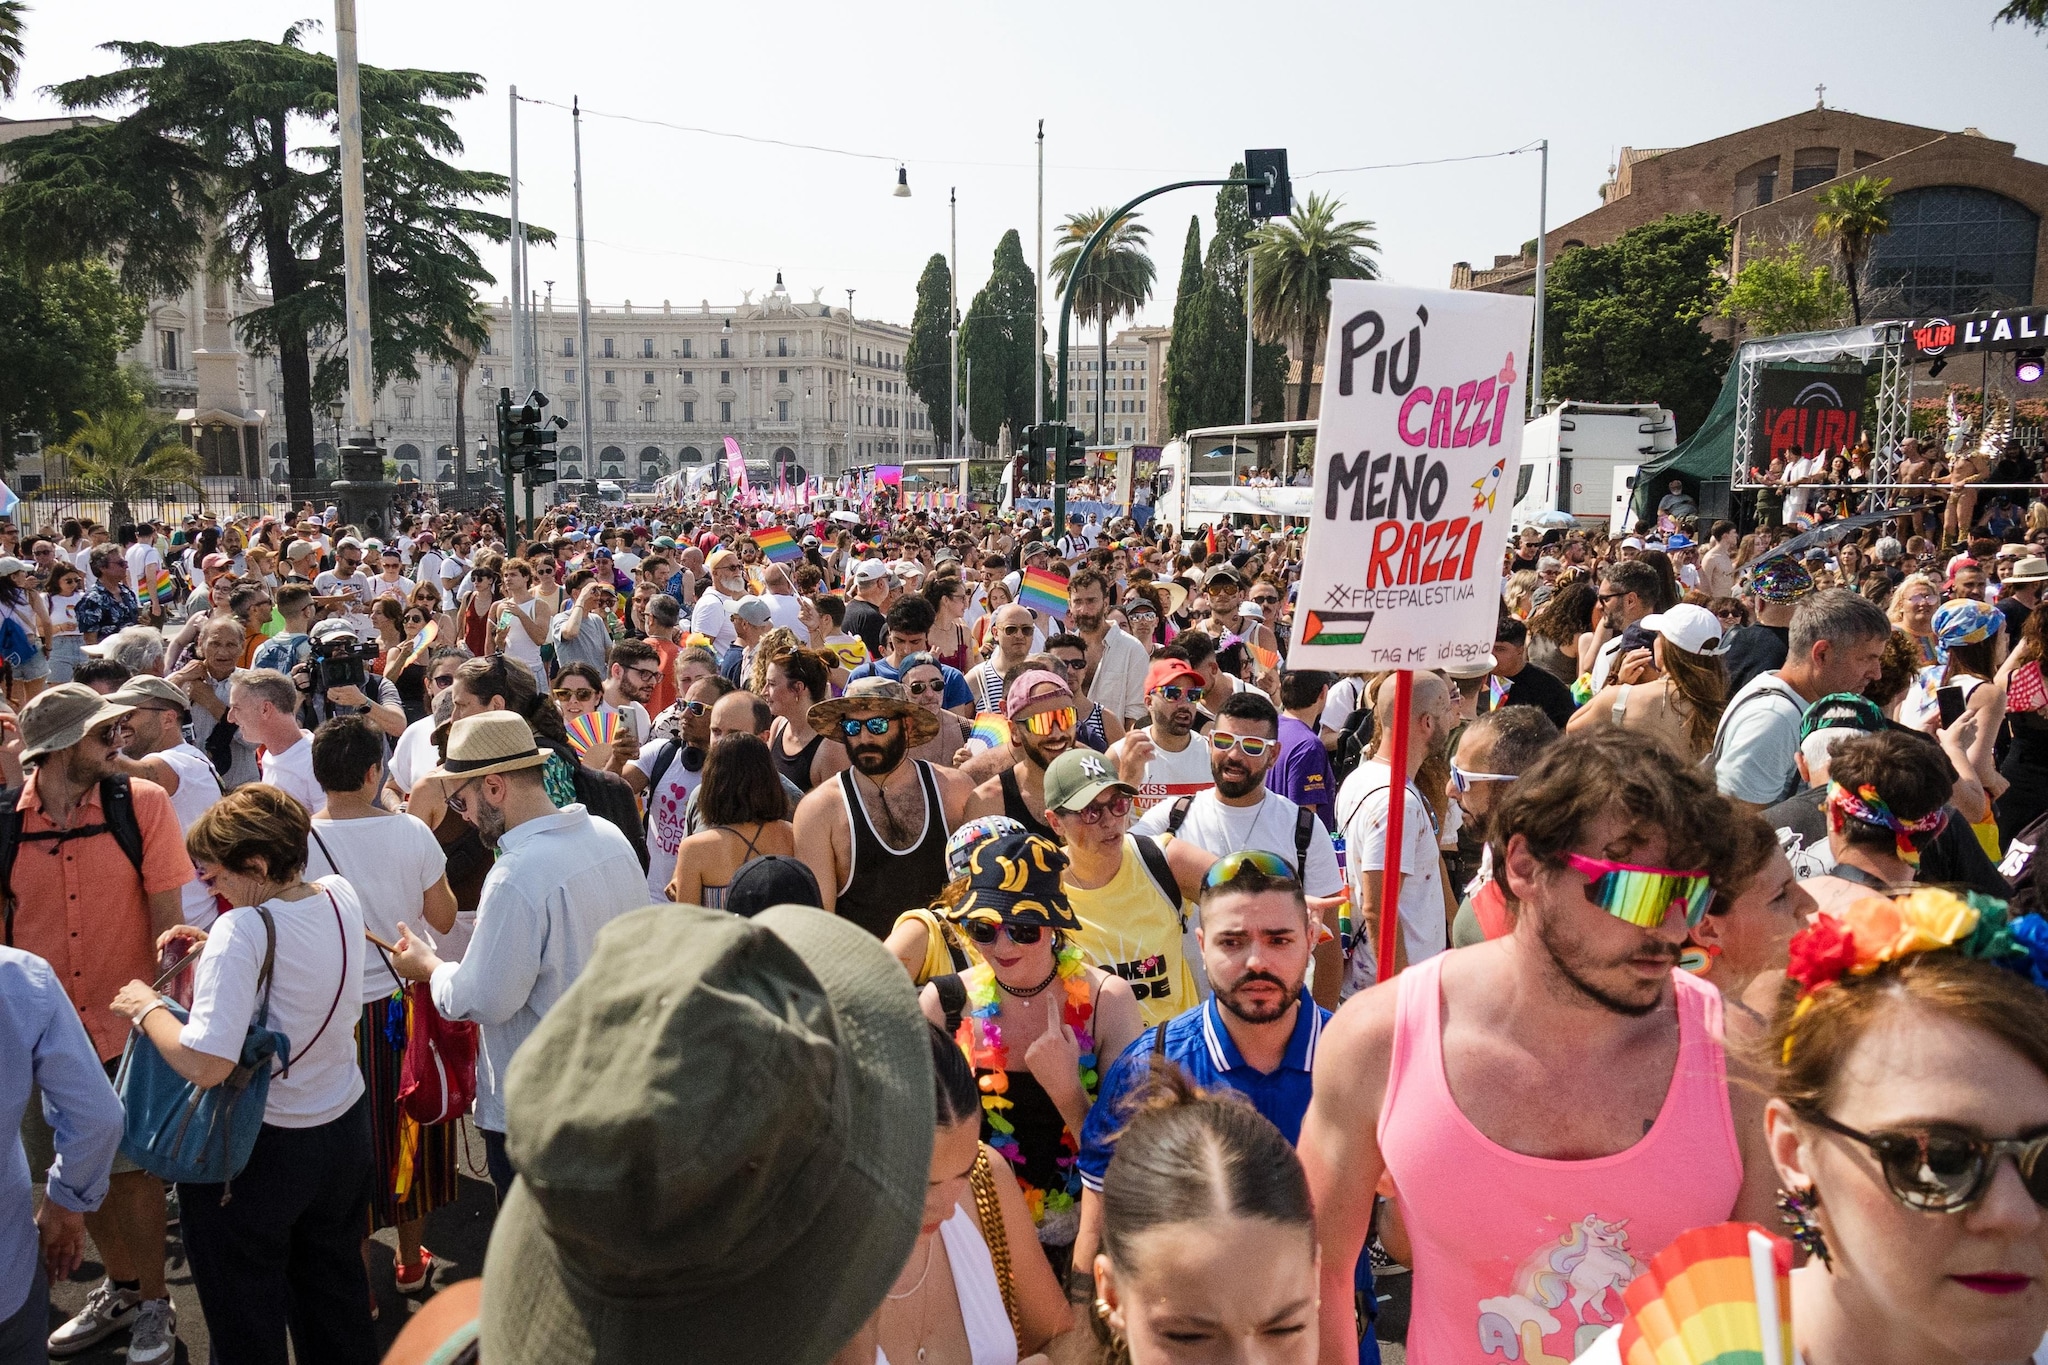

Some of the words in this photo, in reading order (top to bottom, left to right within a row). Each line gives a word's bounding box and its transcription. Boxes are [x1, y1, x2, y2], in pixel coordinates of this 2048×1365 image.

[1398, 375, 1510, 449] CAZZI
[1325, 450, 1448, 521] MENO
[1366, 516, 1484, 590] RAZZI
[1325, 583, 1475, 610] #FREEPALESTINA
[1371, 646, 1402, 663] TAG
[1407, 646, 1428, 662] ME
[1138, 784, 1167, 795] KISS
[658, 822, 684, 843] FOR
